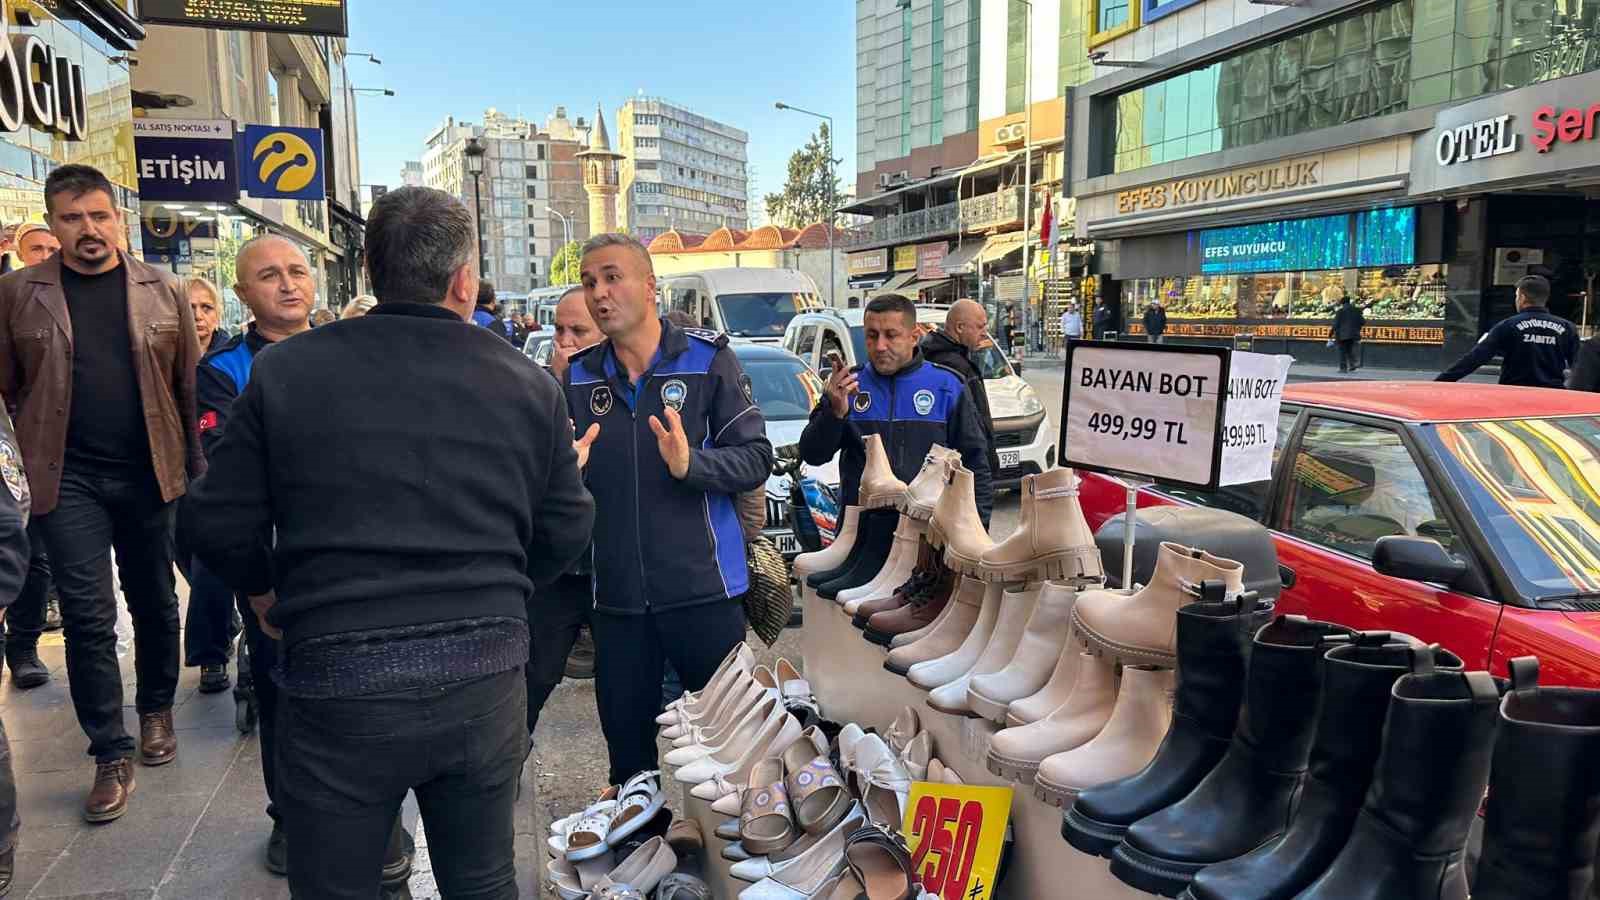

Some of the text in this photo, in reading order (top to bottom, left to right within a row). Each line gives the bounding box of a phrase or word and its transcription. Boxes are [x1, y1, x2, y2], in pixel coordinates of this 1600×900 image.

[134, 123, 147, 132] TAL
[173, 124, 211, 133] NOKTASI
[1436, 114, 1518, 167] OTEL
[1116, 160, 1321, 214] EFES KUYUMCULUK
[1205, 240, 1286, 258] EFES KUYUMCU
[1080, 367, 1208, 398] BAYAN BOT
[1226, 377, 1278, 399] AYAN BOT
[1087, 412, 1188, 444] 499,99 TL
[1221, 423, 1267, 449] 499,99 TL
[911, 795, 984, 900] 250
